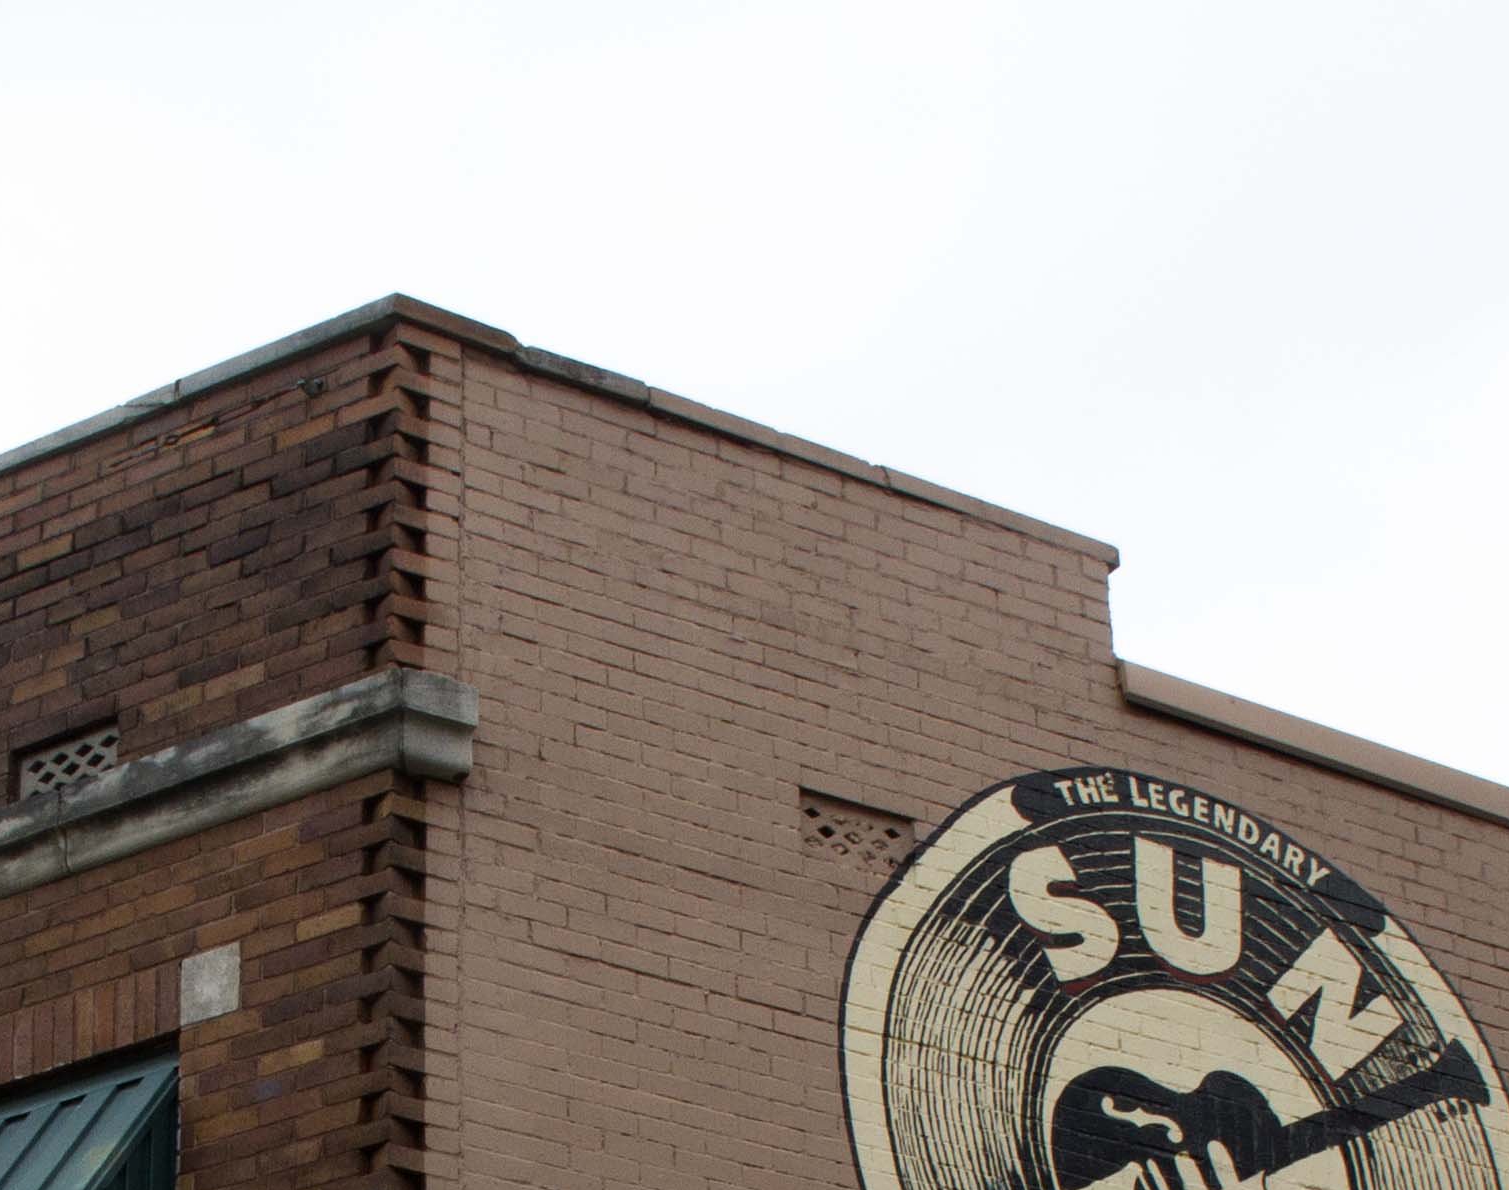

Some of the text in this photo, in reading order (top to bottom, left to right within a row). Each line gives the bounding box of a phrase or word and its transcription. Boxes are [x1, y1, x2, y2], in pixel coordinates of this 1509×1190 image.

[1053, 772, 1330, 887] THE LEGENDARY
[1008, 834, 1410, 1080] SUN
